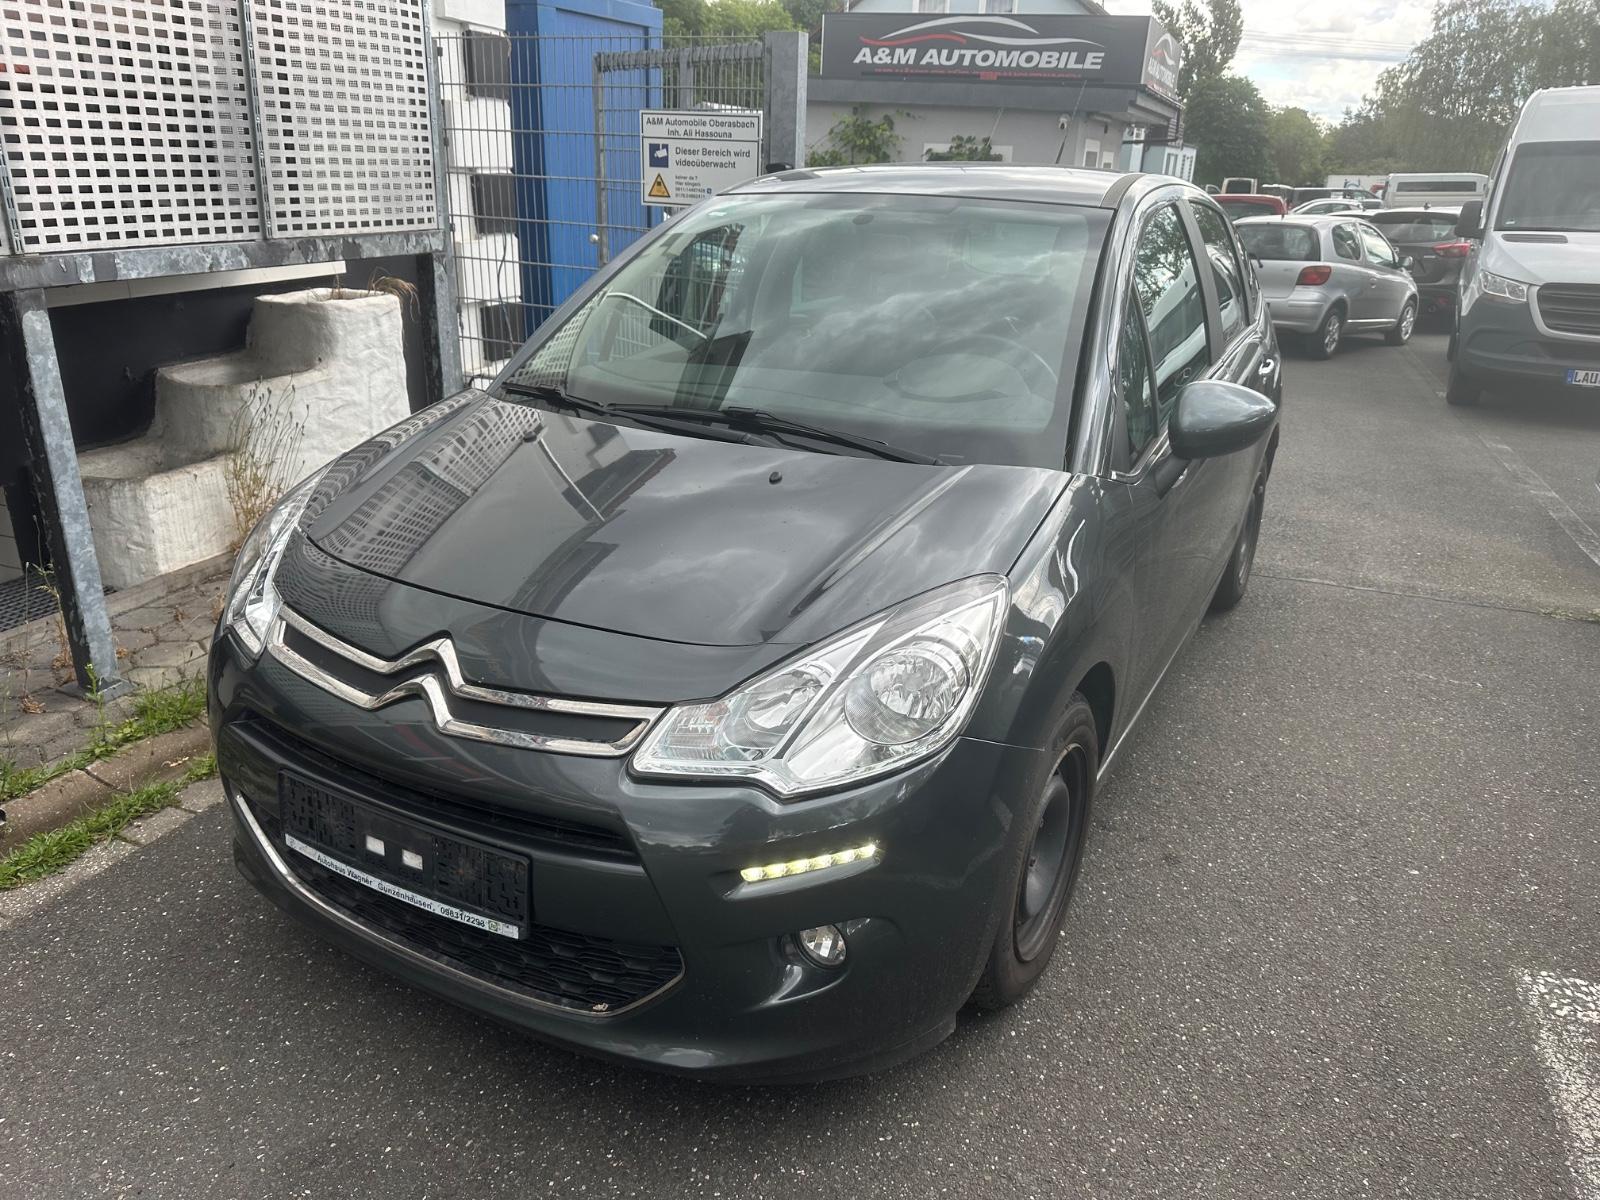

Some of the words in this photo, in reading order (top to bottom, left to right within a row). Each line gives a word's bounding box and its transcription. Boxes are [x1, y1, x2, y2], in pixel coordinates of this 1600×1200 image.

[853, 47, 917, 65] A&M
[919, 48, 1106, 70] AUTOMOBILE
[646, 118, 664, 126] A&M
[665, 118, 707, 127] Automobile
[709, 119, 755, 129] Oberasbach
[667, 129, 682, 137] Inh.
[683, 129, 693, 137] Ali
[694, 129, 733, 139] Hassouna
[675, 146, 700, 156] Dieser
[701, 147, 732, 157] Bereich
[733, 148, 751, 158] wird
[675, 158, 737, 169] videoüberwacht
[1574, 372, 1599, 384] LAU
[317, 853, 346, 875] Autohaus
[346, 868, 373, 886] Wagner
